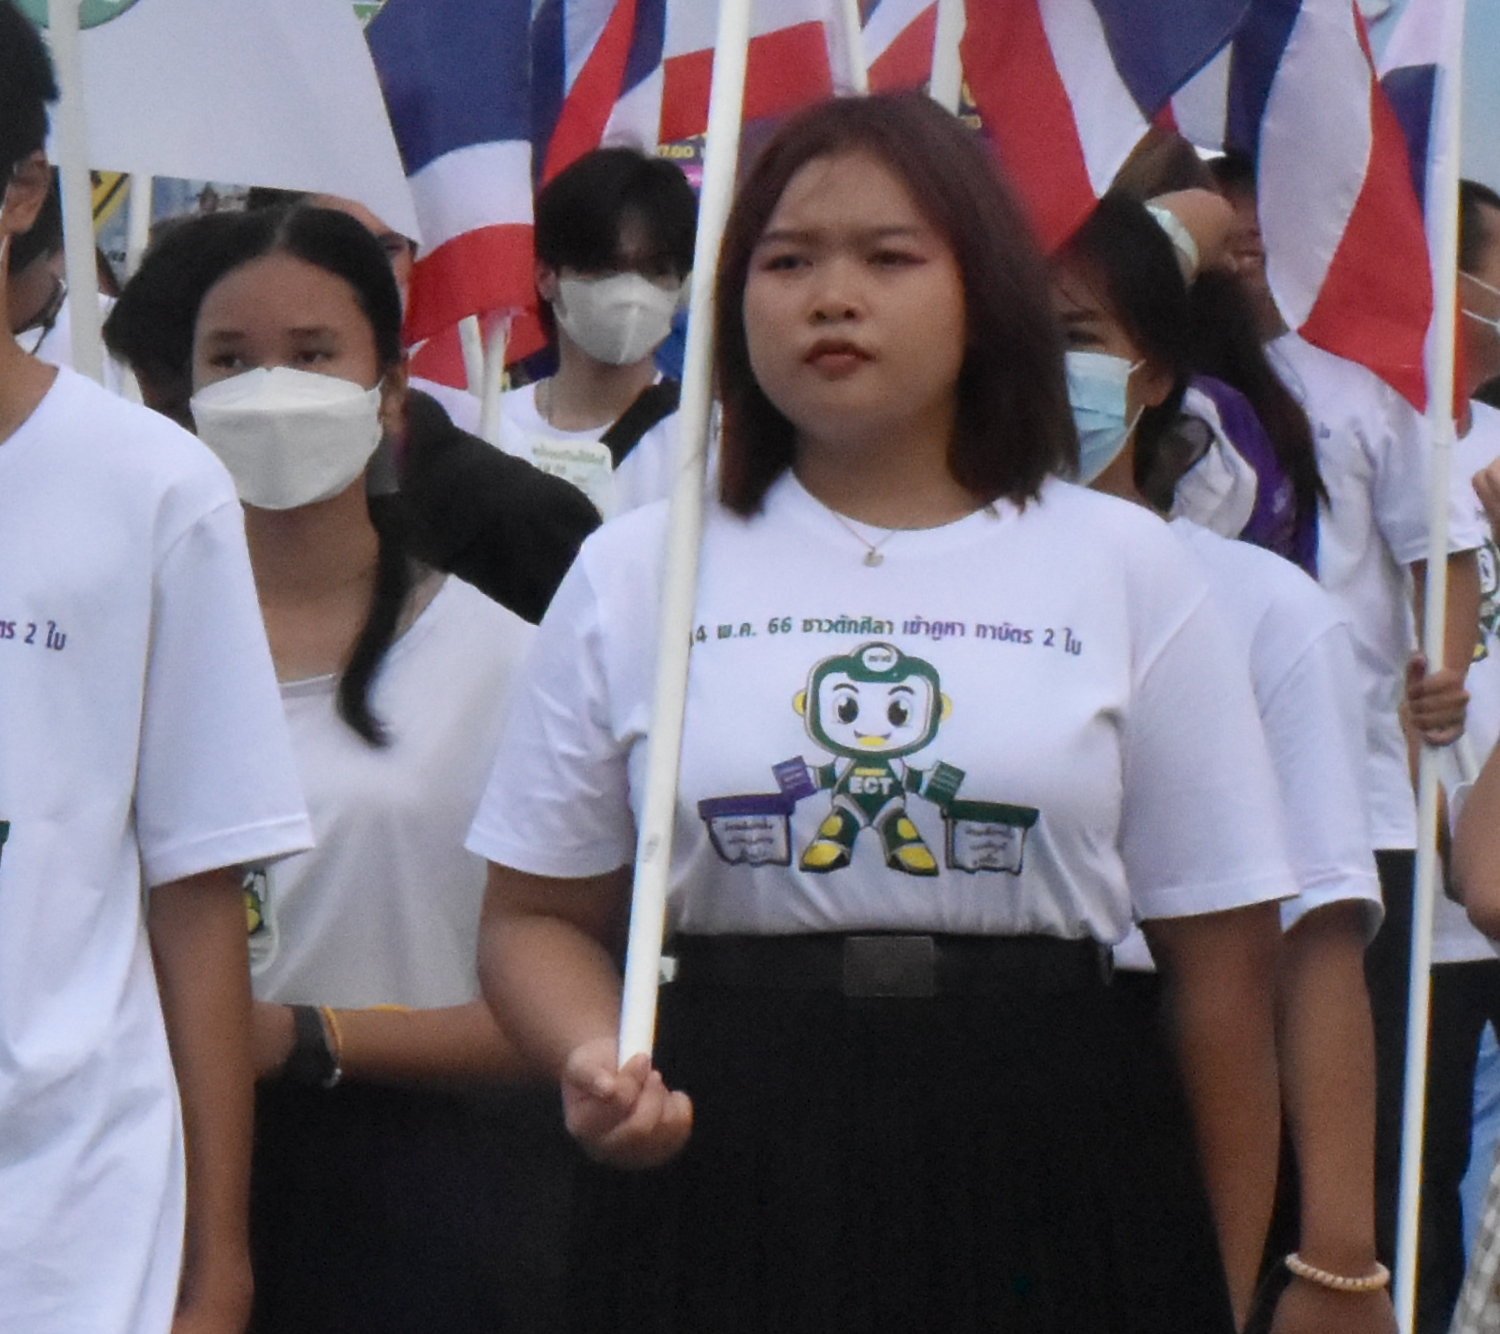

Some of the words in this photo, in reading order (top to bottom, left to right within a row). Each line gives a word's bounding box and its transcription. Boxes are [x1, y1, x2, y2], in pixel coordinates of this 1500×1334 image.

[24, 622, 36, 644] 2
[46, 620, 67, 652] ใบ
[717, 621, 757, 640] พ.ค.
[767, 616, 793, 635] 66
[802, 615, 895, 636] ชาวตักศิลา
[903, 614, 965, 642] เข้าคูหา
[975, 621, 1033, 645] กาบัตร
[1043, 628, 1056, 648] 2
[1064, 628, 1083, 657] ใบ
[849, 775, 893, 797] ECT
